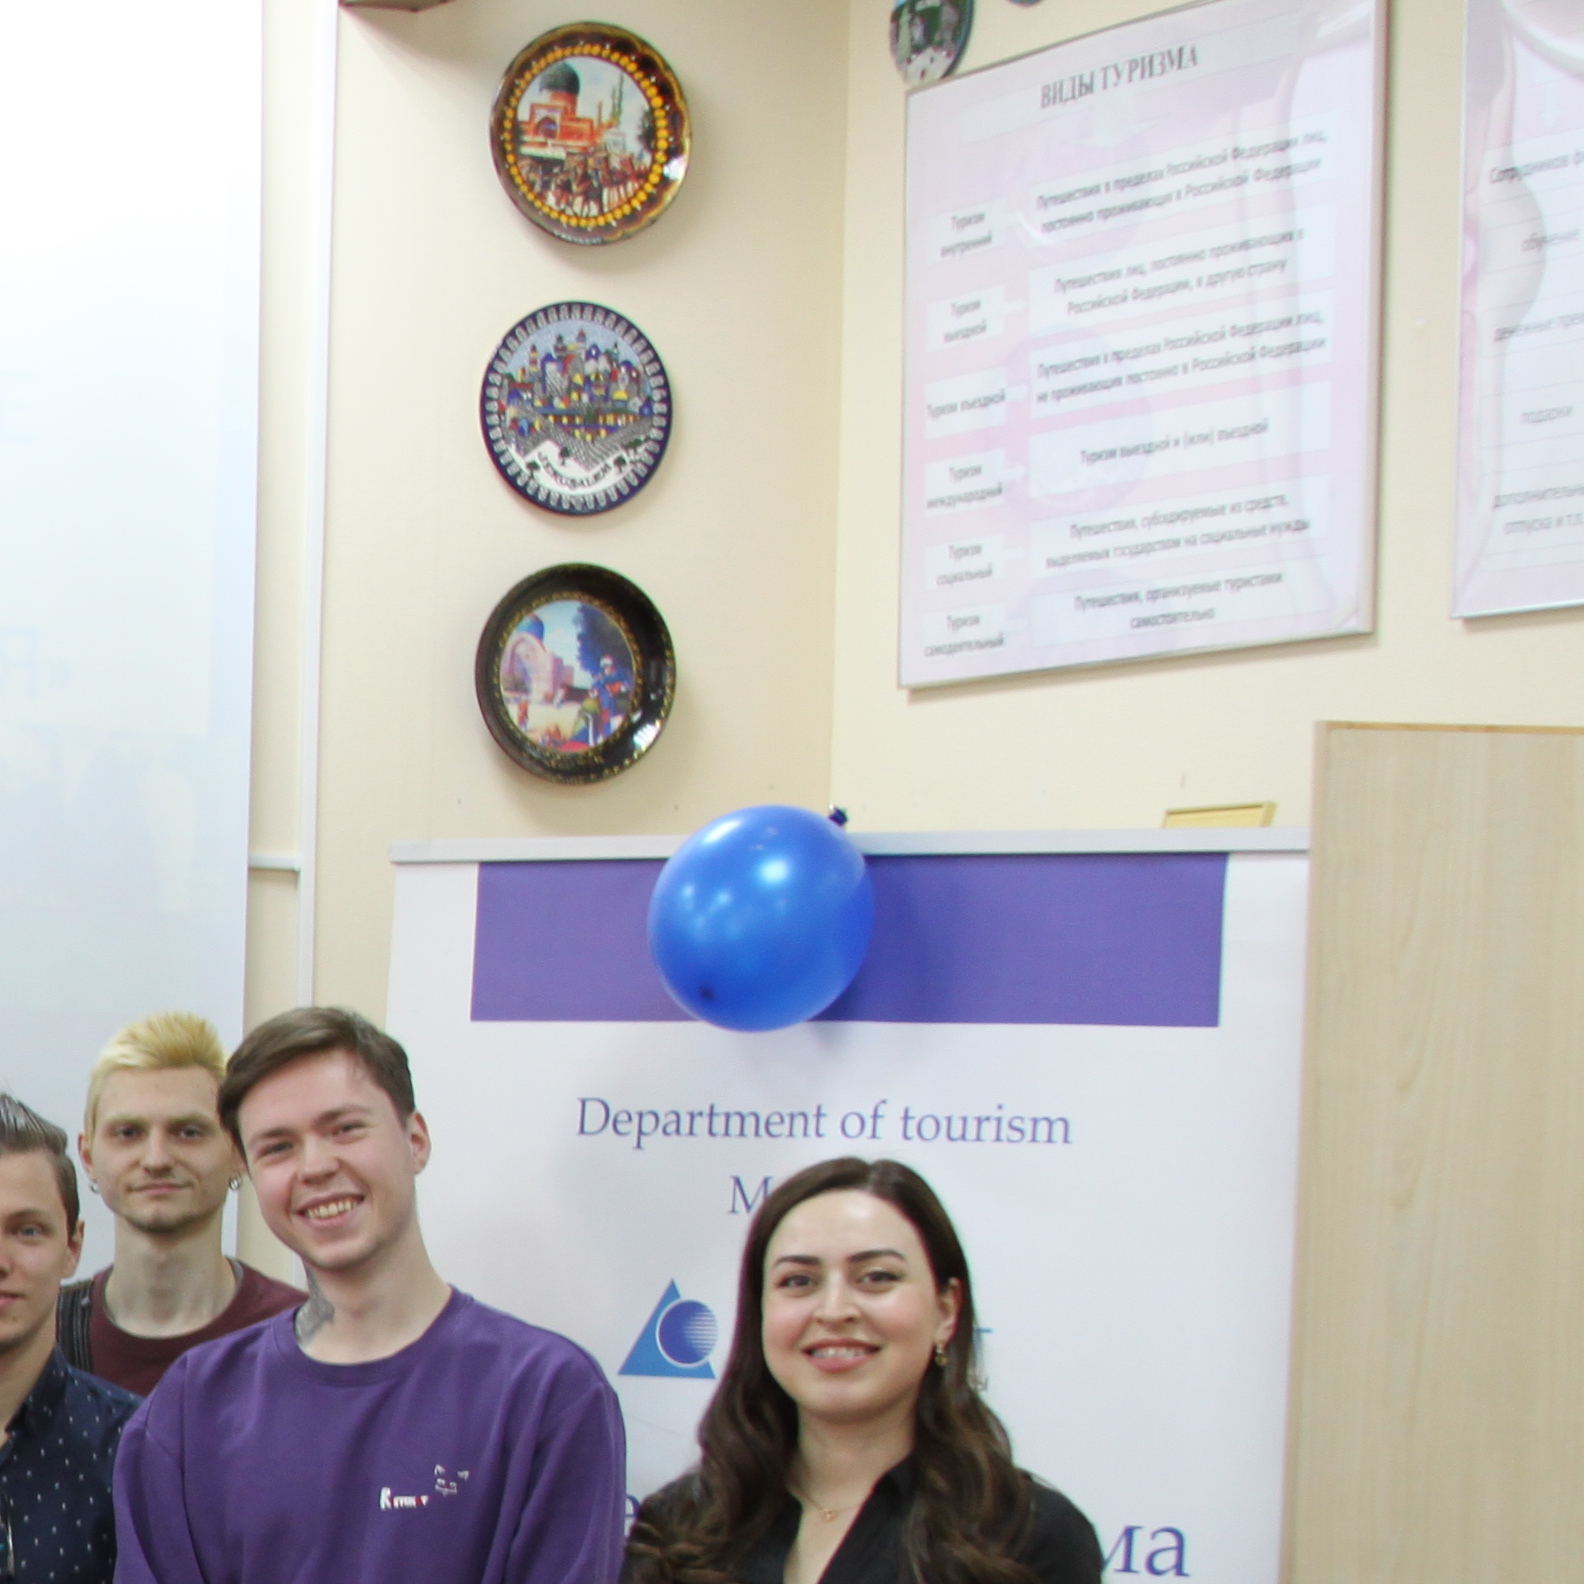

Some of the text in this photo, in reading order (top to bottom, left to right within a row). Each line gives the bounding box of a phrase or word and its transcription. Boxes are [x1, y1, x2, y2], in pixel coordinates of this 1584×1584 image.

[1040, 45, 1199, 109] ВИДЫ ТУРИЗМА
[576, 1097, 1074, 1150] Department of tourism
